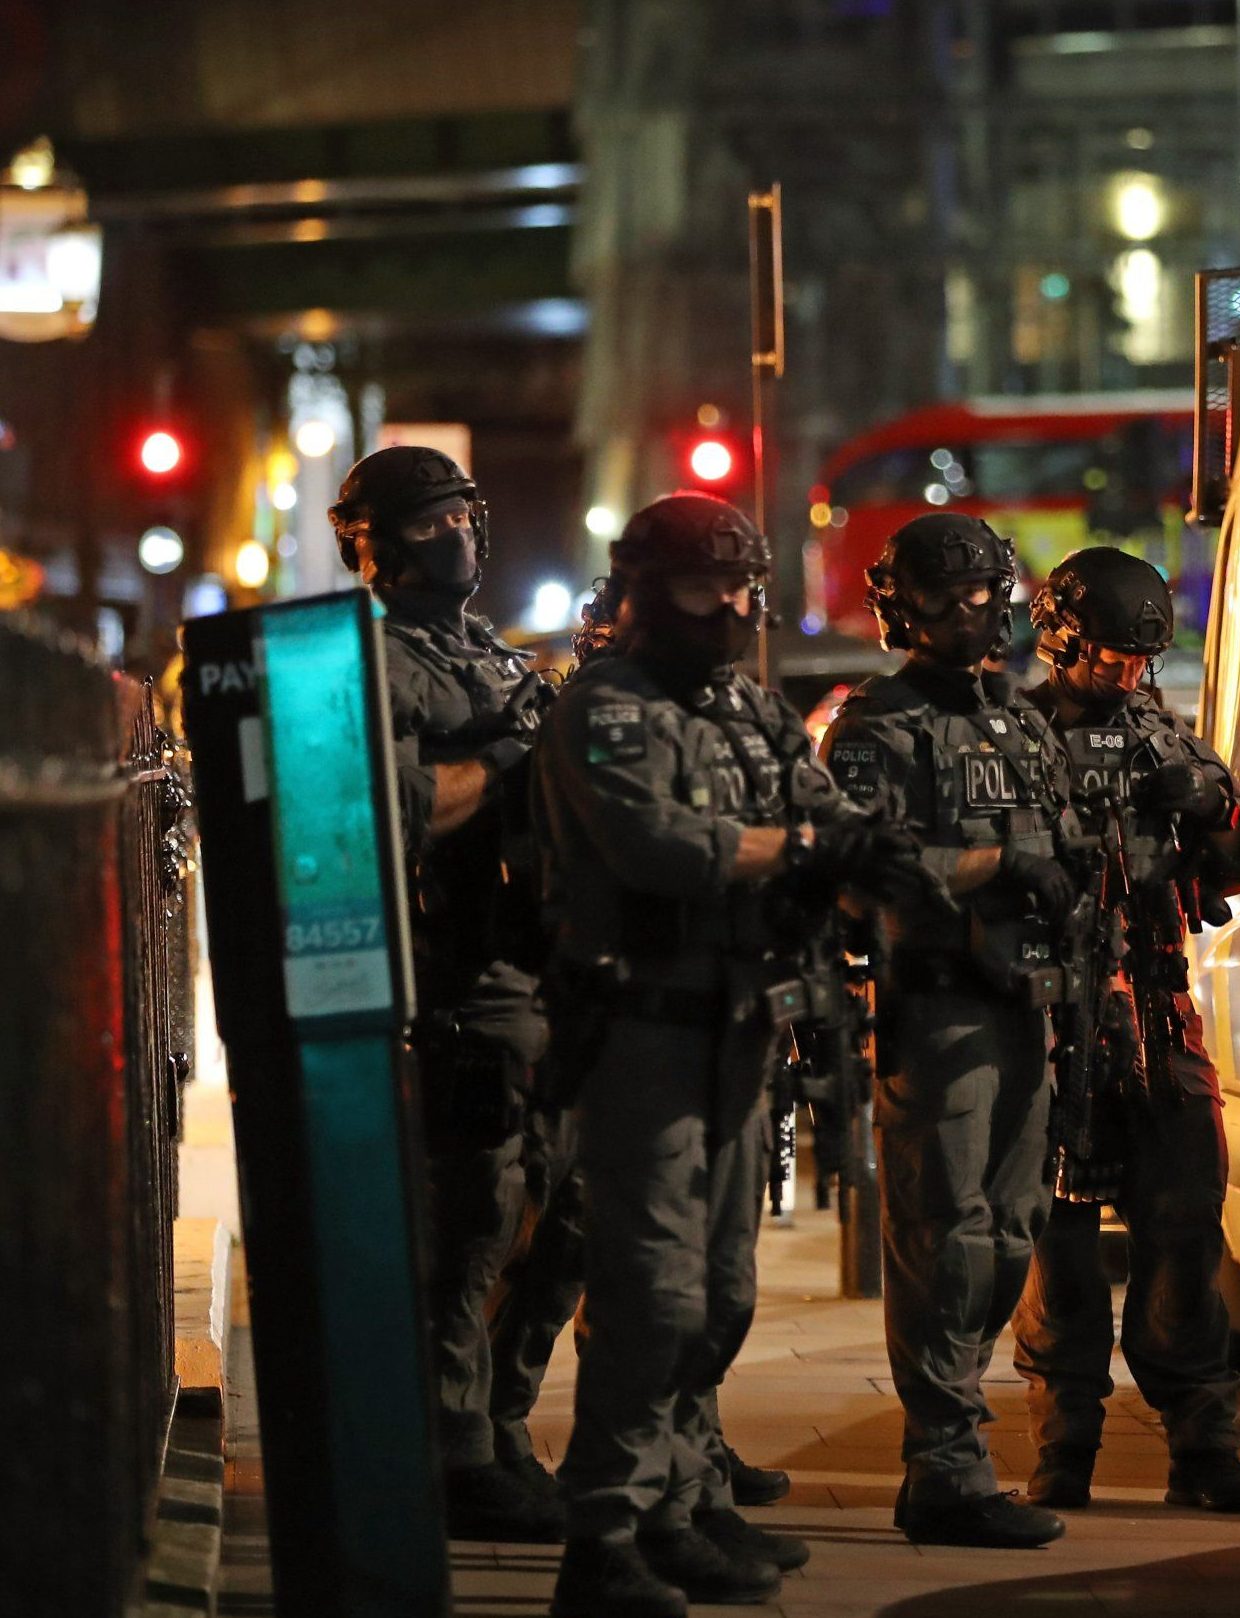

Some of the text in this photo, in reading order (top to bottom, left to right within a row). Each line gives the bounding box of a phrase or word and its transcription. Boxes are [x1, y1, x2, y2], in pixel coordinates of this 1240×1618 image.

[199, 660, 261, 696] PAY
[833, 750, 876, 763] POLICE
[847, 765, 859, 778] 9
[970, 759, 1040, 800] POLE
[286, 917, 380, 951] 84557
